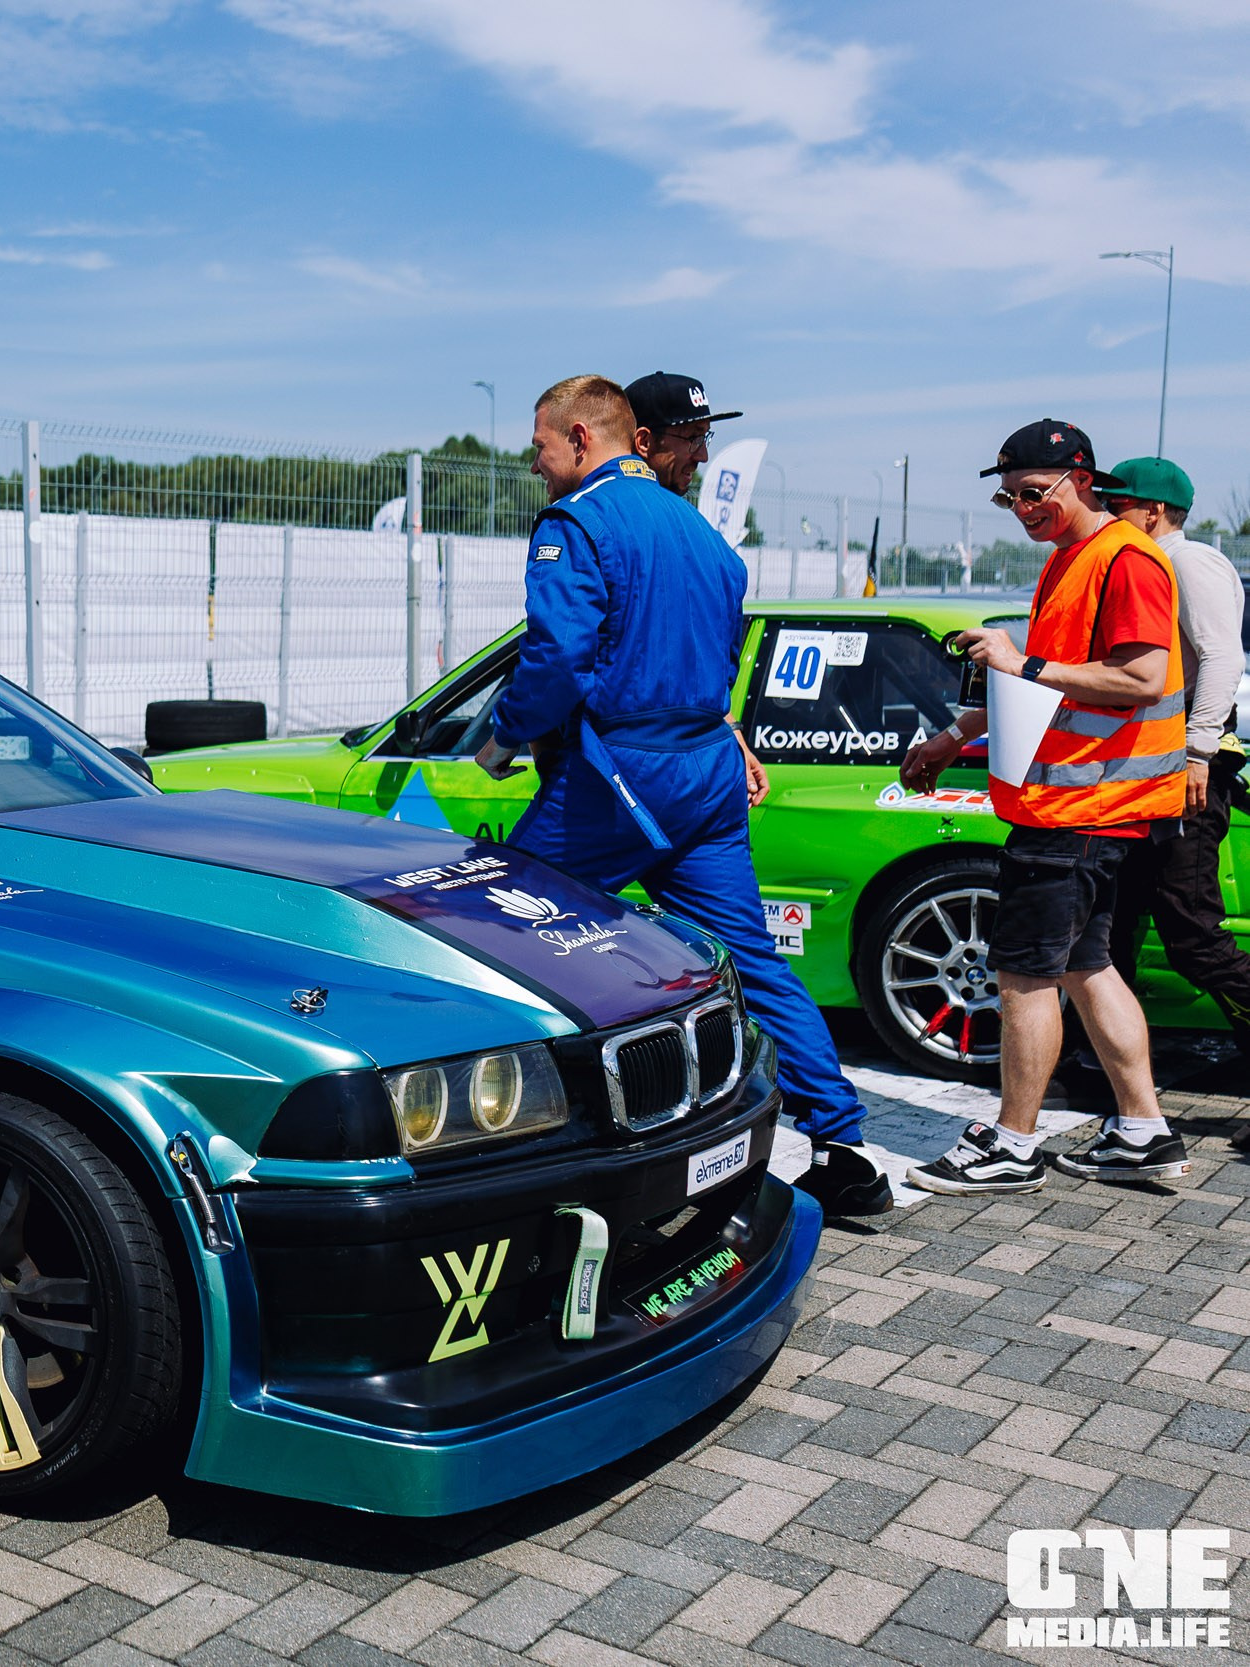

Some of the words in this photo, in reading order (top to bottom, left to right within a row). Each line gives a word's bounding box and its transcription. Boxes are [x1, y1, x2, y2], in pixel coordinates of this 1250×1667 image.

[538, 549, 560, 557] OMP
[775, 646, 821, 690] 40
[754, 725, 899, 755] Кожеуров
[383, 867, 449, 888] WEST
[446, 857, 509, 875] LAKE
[431, 879, 469, 891] МЕСТО
[538, 920, 628, 956] Shambala
[641, 1293, 669, 1319] WE
[662, 1278, 694, 1305] ARE
[689, 1246, 742, 1287] #VENOM
